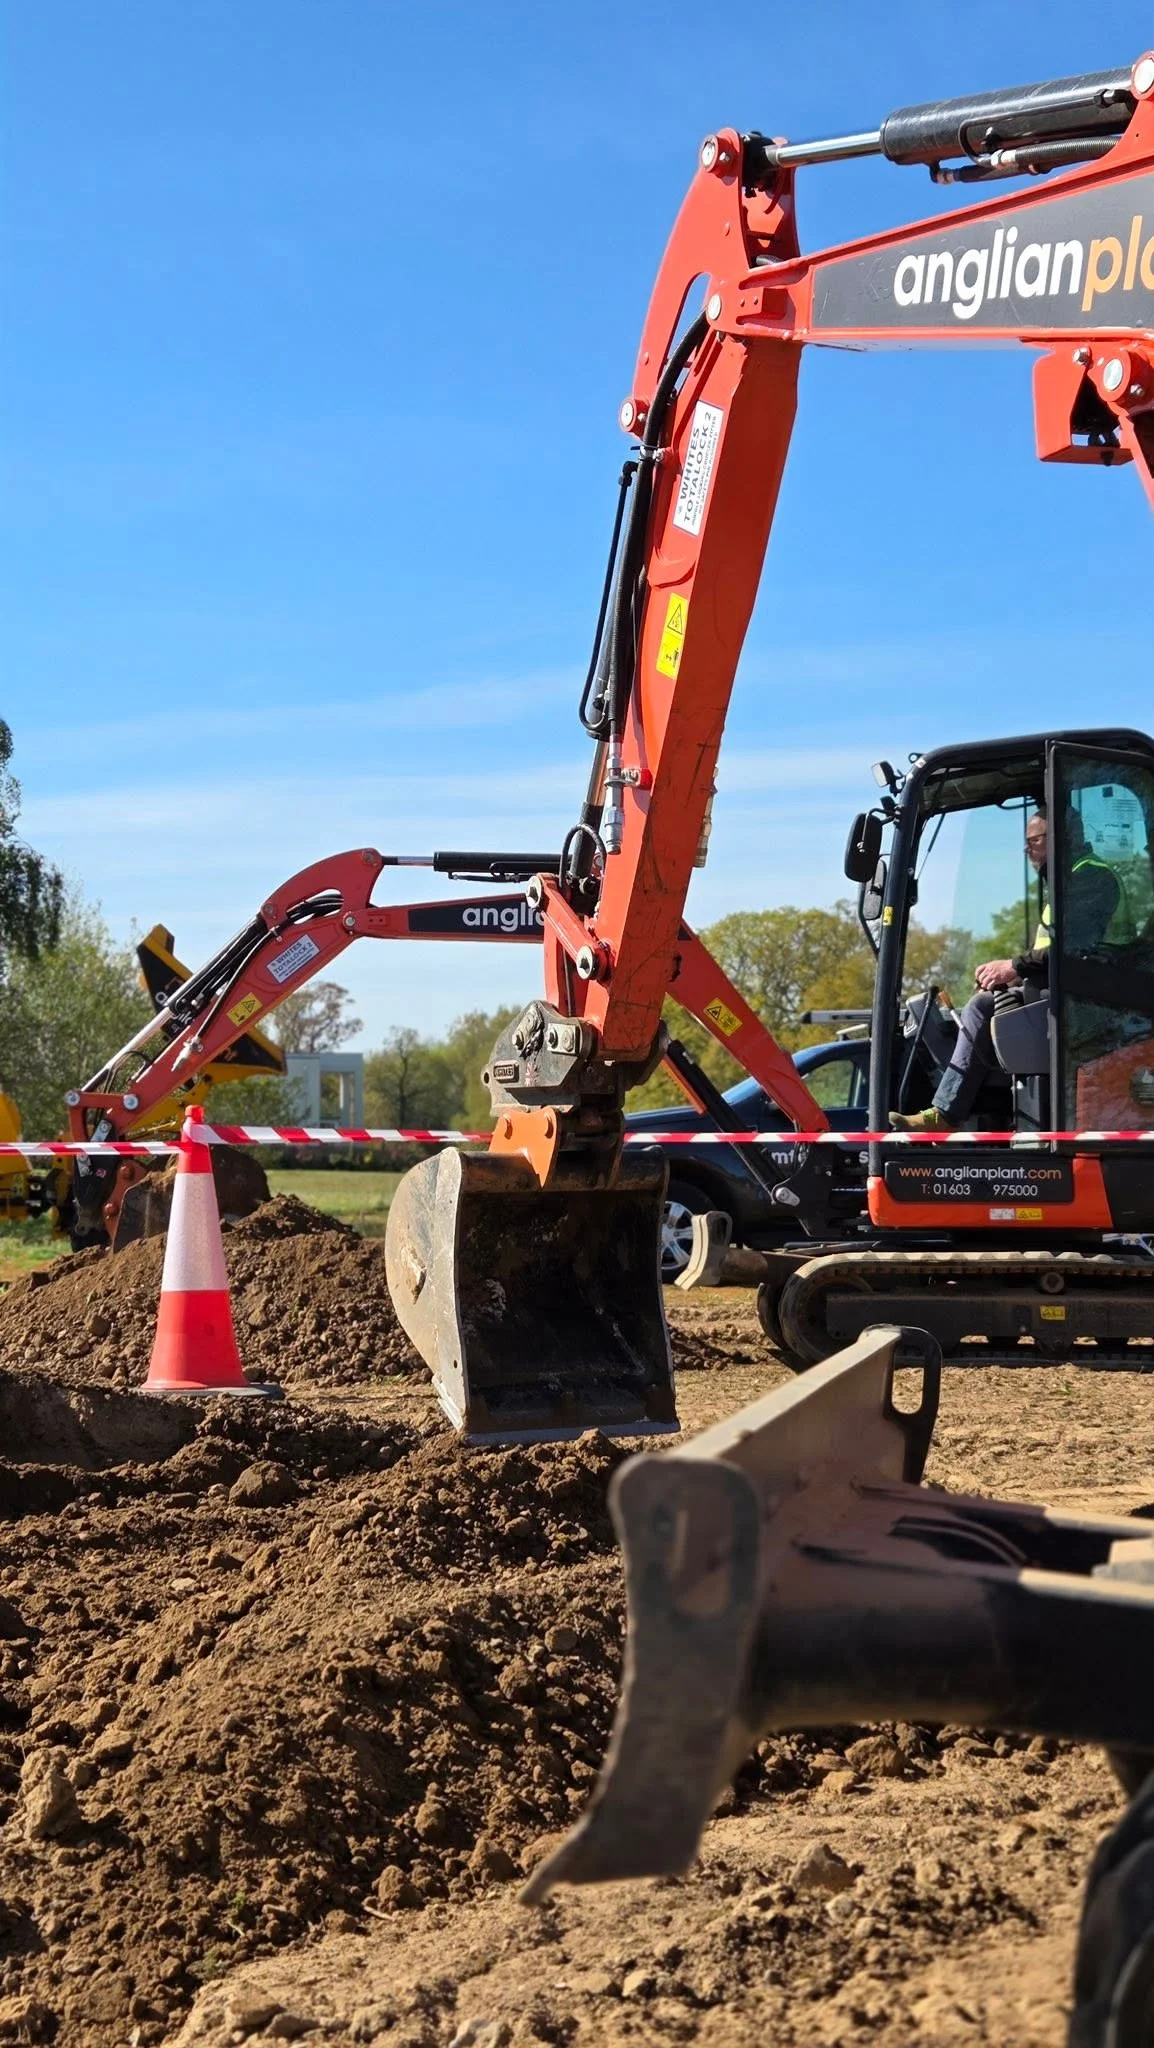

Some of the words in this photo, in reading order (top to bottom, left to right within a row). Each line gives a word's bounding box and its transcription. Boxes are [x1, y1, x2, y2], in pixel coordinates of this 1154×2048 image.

[680, 427, 700, 500] WHITES
[684, 425, 709, 522] TOTALOCK
[704, 411, 712, 421] 2
[276, 942, 302, 964] WHITES
[899, 1166, 1062, 1180] www.anglianplant.com
[921, 1184, 930, 1195] T:
[933, 1183, 971, 1195] 01603
[993, 1184, 1038, 1196] 975000
